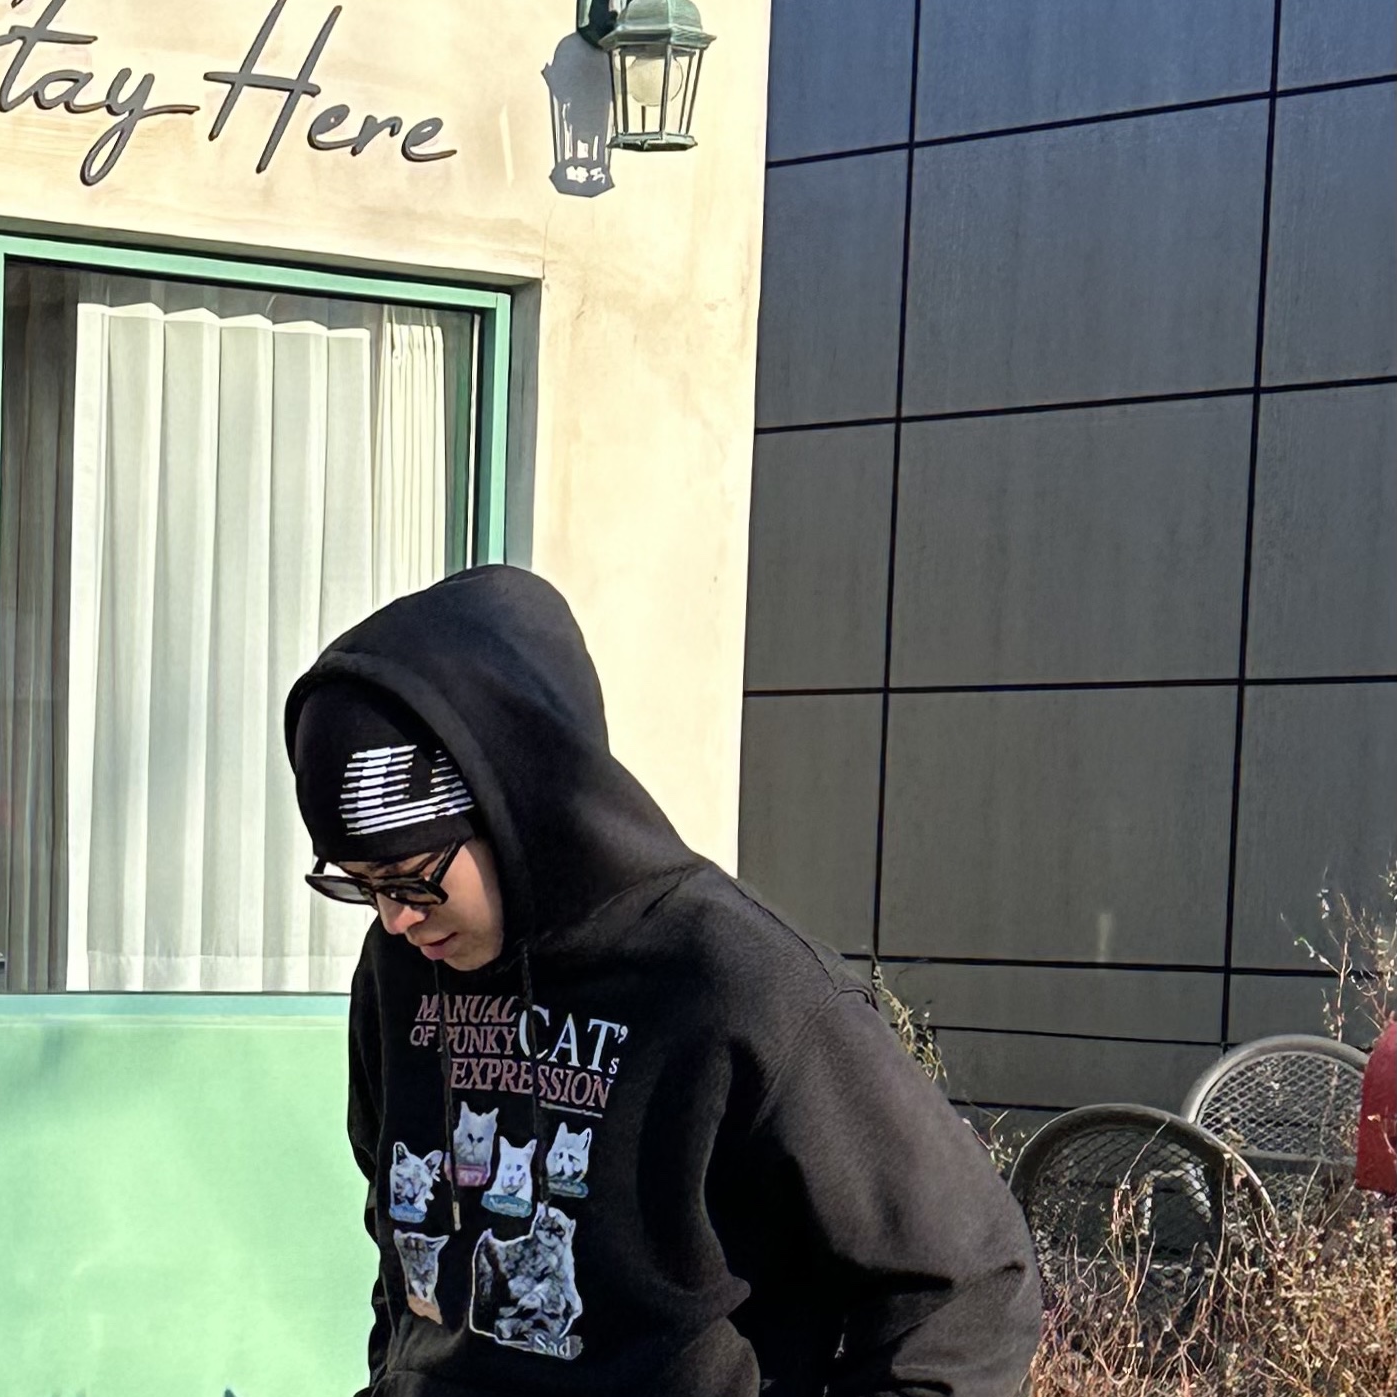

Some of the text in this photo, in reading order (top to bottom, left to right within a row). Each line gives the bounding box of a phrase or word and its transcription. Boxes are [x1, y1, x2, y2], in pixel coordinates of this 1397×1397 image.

[203, 0, 458, 174] Here
[414, 993, 519, 1023] MANUAL
[409, 1025, 437, 1047] OF
[451, 1057, 612, 1109] EXPRESSION
